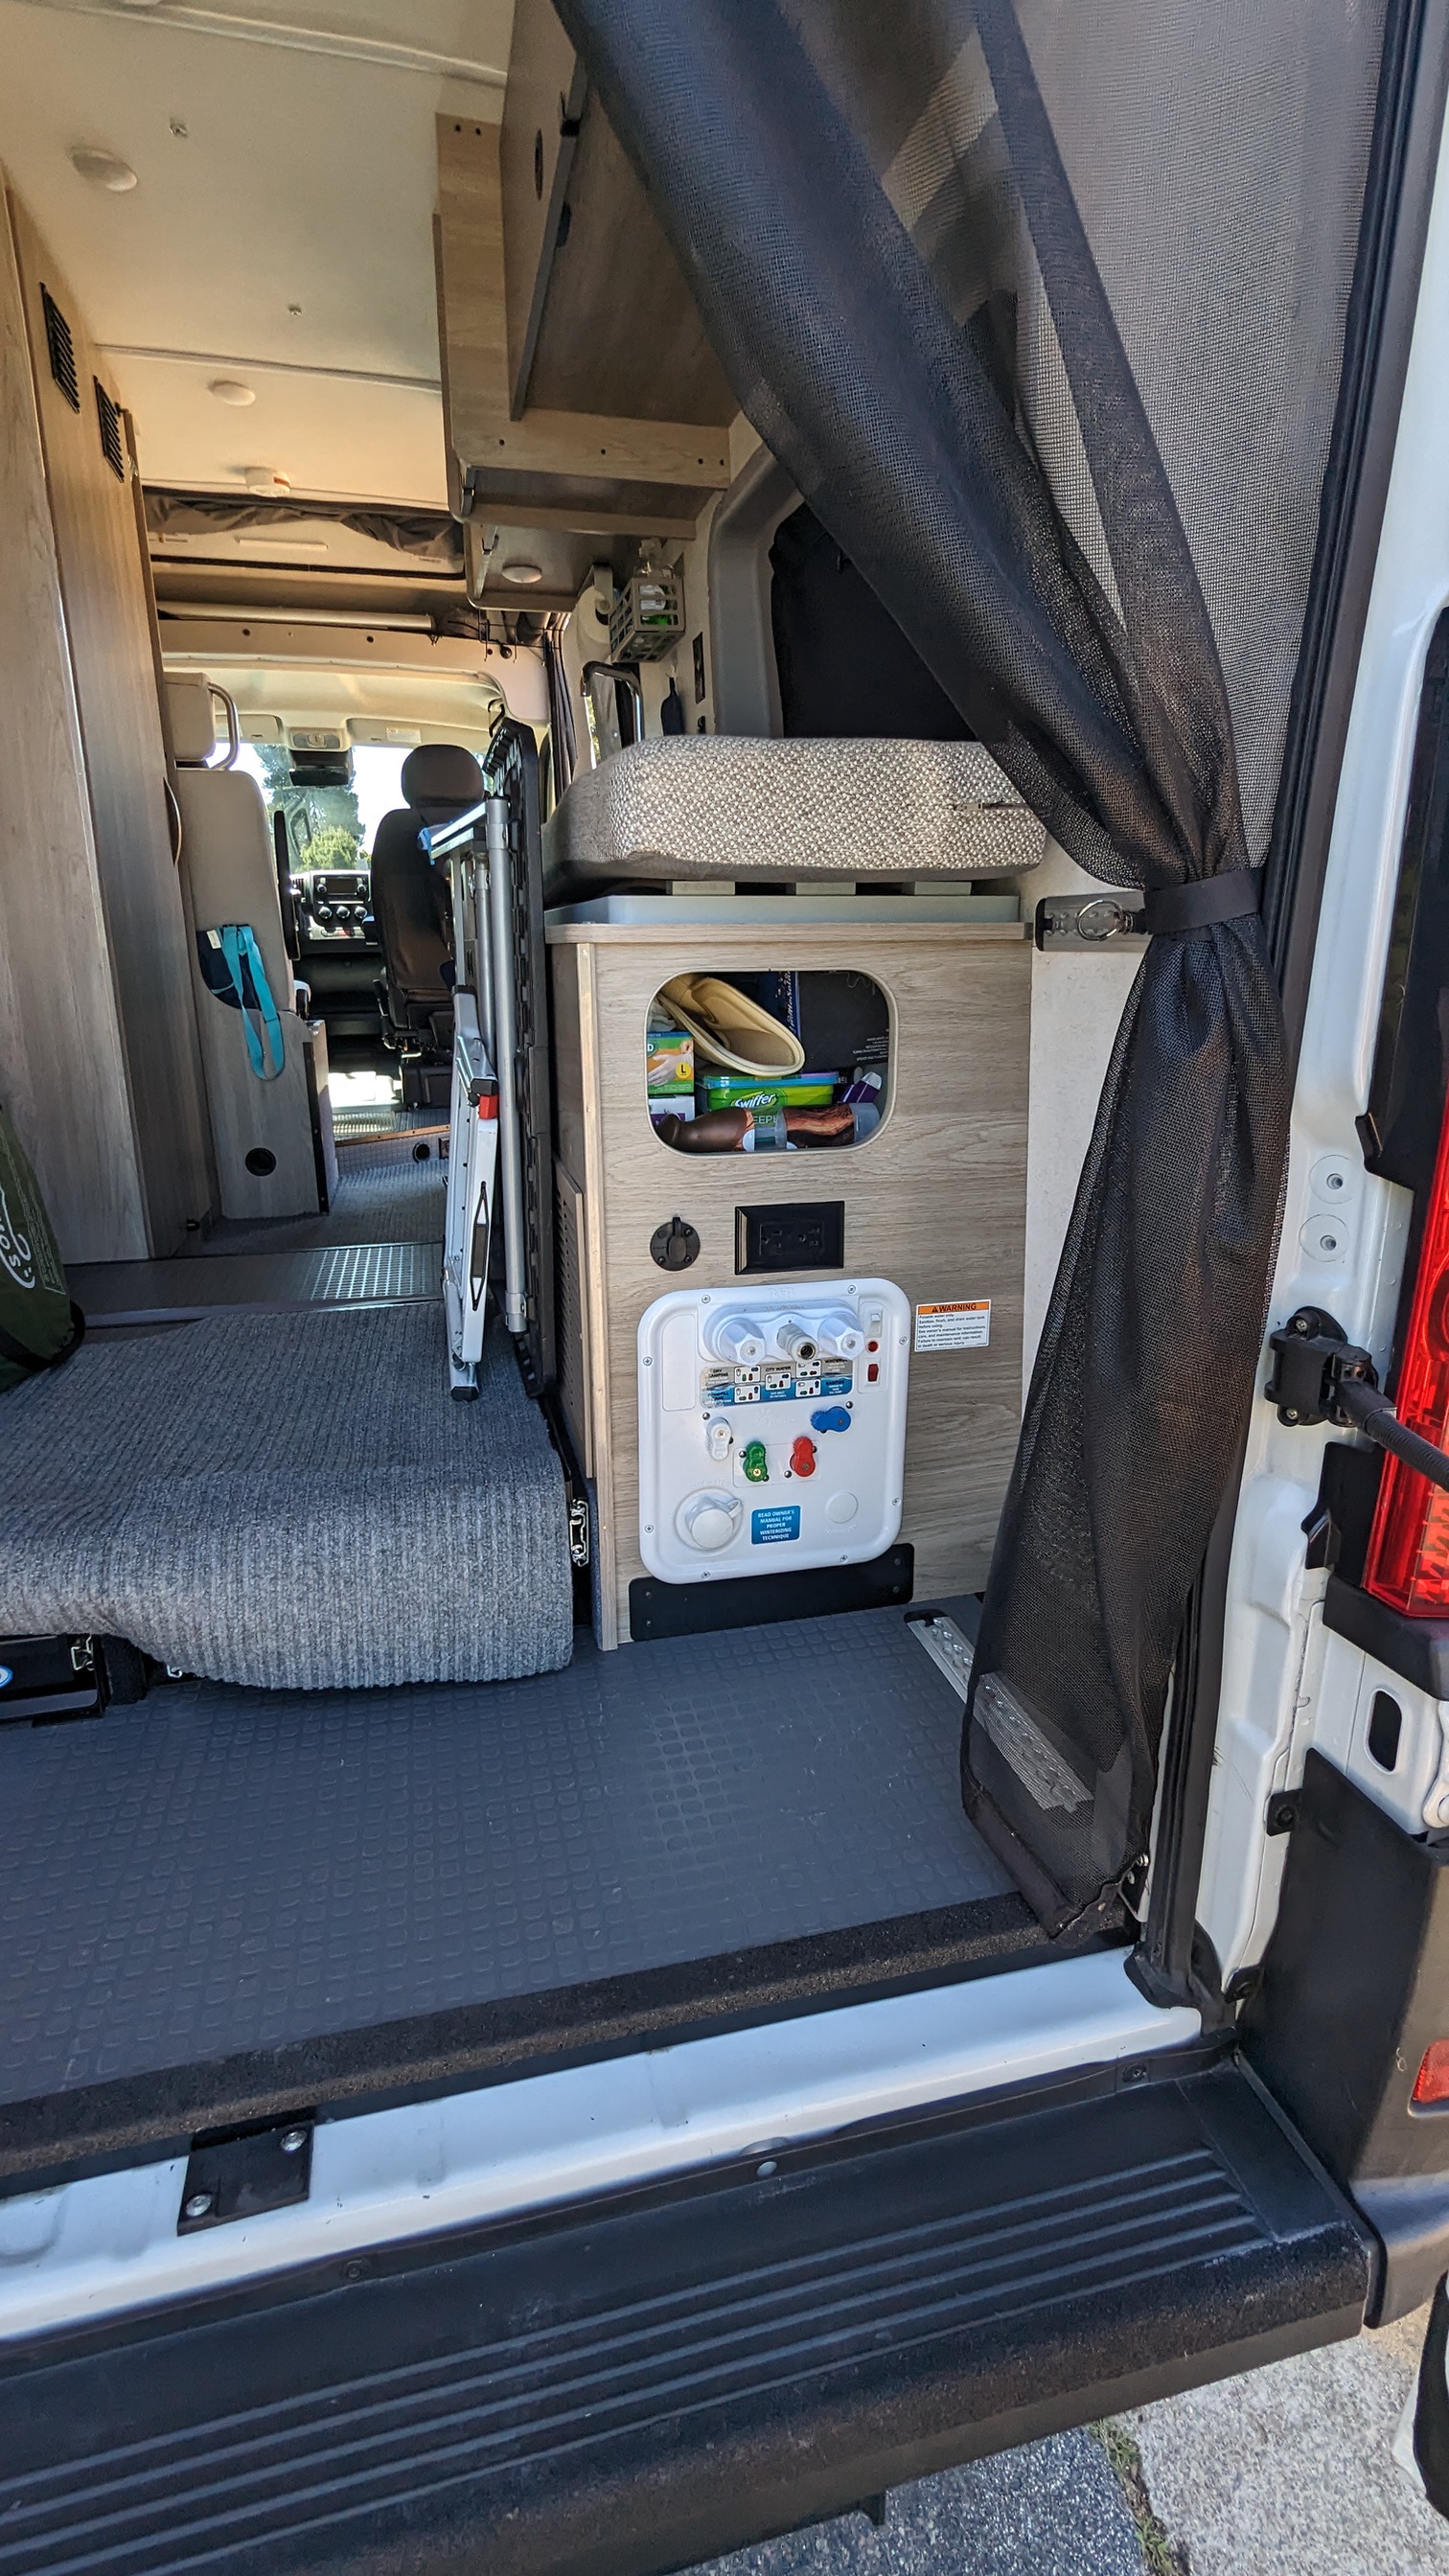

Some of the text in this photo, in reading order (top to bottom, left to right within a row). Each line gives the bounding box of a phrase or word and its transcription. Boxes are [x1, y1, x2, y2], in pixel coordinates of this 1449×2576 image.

[681, 1064, 687, 1073] L
[735, 1094, 776, 1108] Swiffer
[940, 1303, 977, 1312] WARNING
[759, 1527, 792, 1535] WINTERIZING
